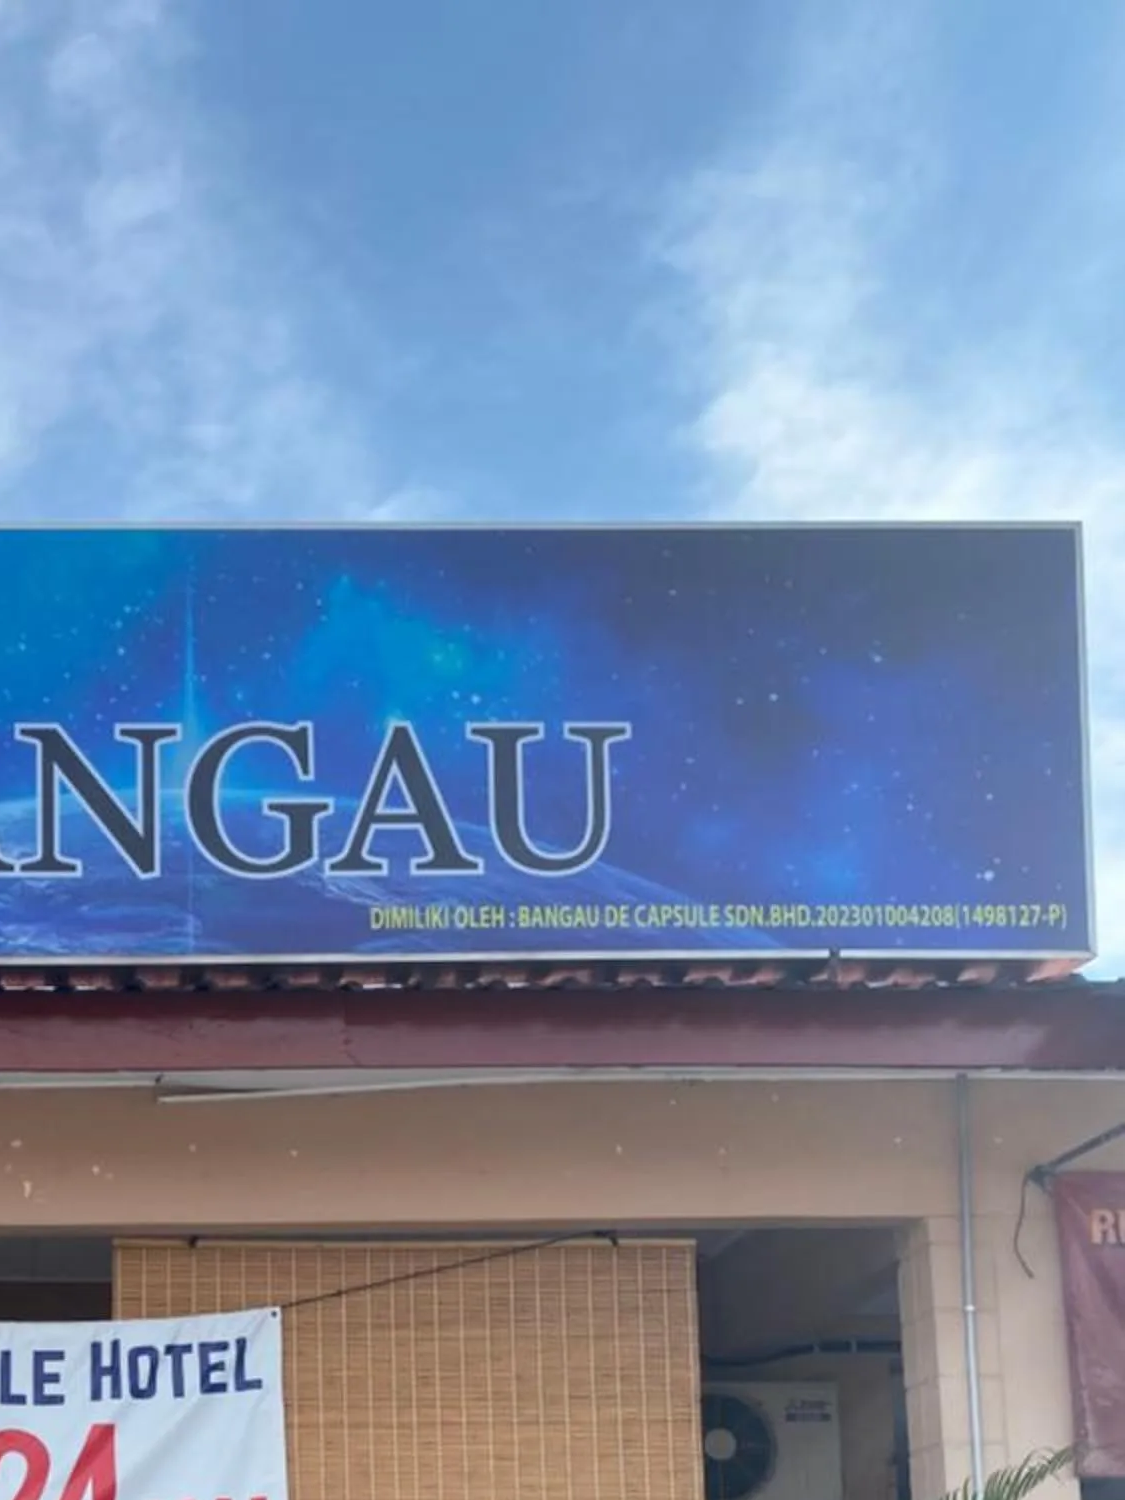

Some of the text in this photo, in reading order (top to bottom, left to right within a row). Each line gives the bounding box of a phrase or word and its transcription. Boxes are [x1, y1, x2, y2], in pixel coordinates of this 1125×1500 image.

[369, 906, 450, 930] DIMILIKI
[453, 905, 505, 929] OLEH
[518, 905, 600, 929] BANGAU
[604, 905, 630, 928] DE
[633, 904, 720, 928] CAPSULE
[89, 1337, 263, 1401] HOTEL
